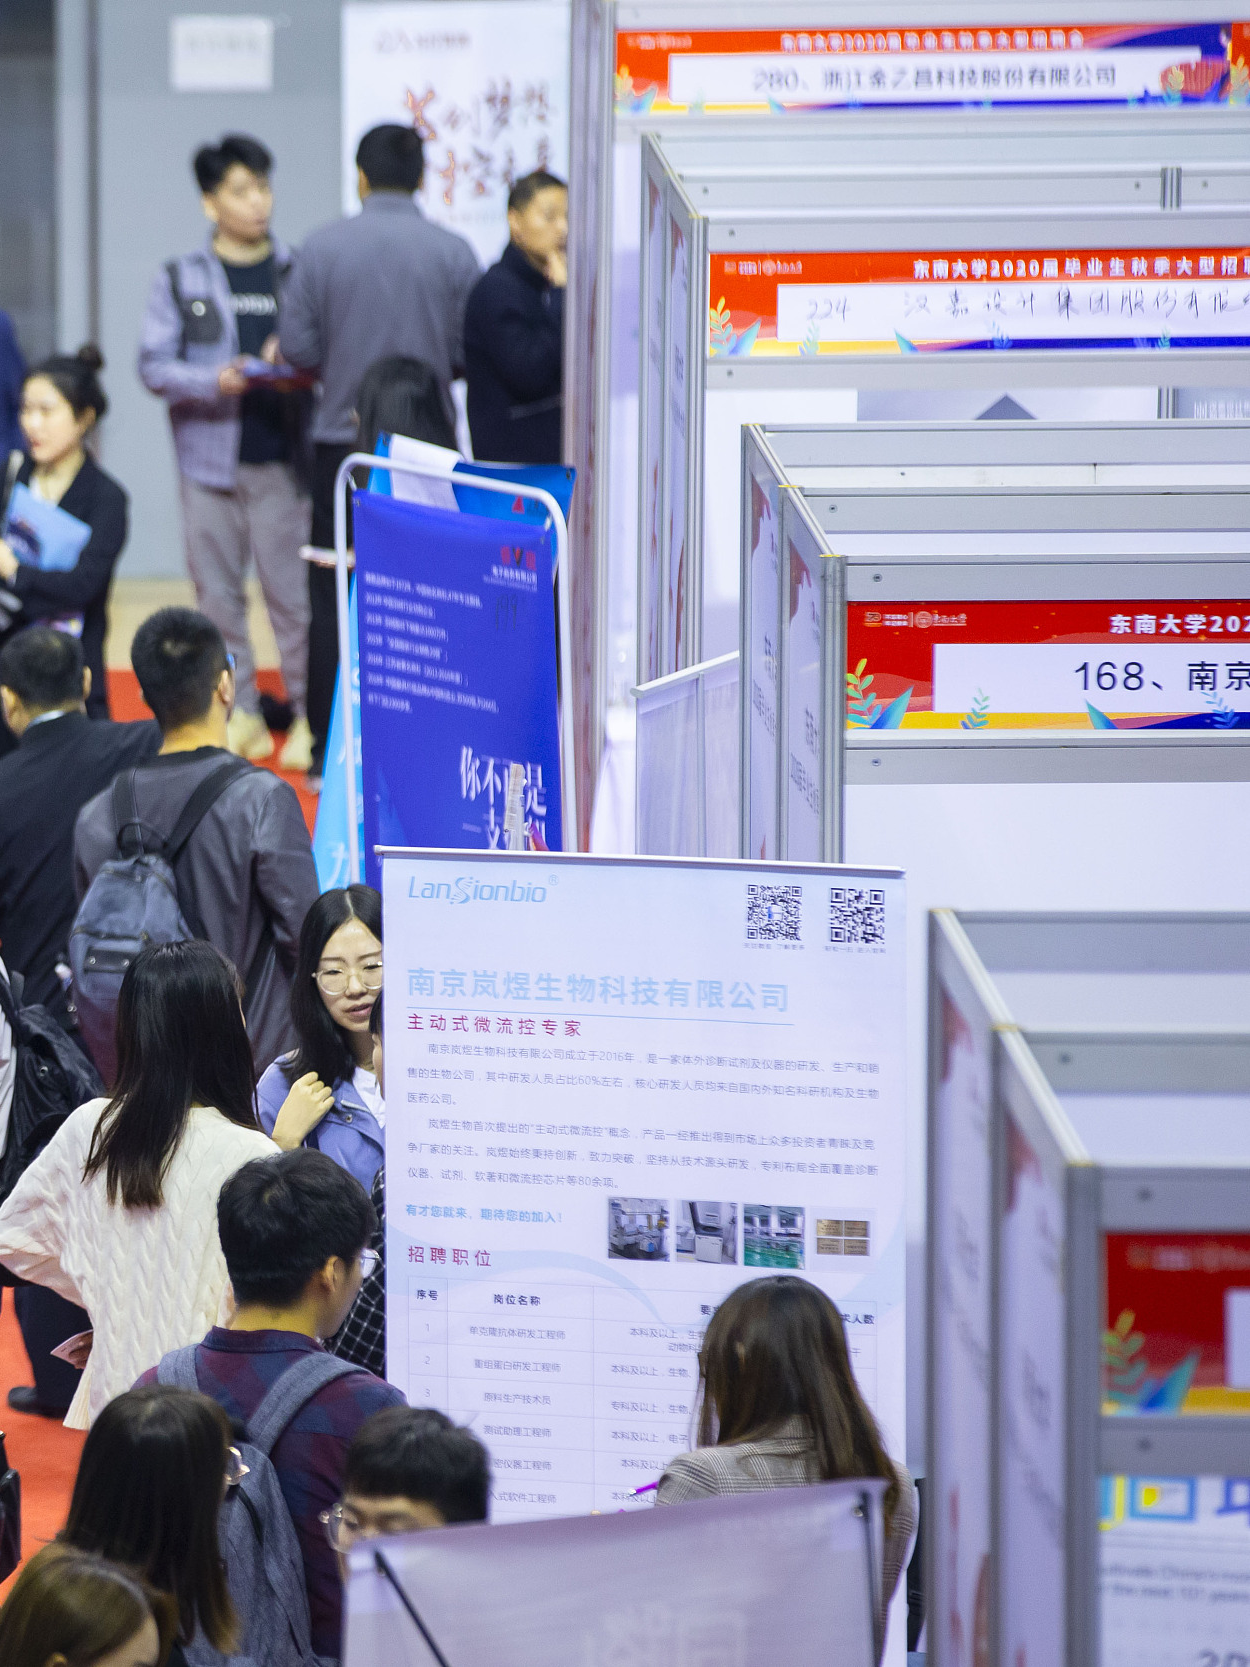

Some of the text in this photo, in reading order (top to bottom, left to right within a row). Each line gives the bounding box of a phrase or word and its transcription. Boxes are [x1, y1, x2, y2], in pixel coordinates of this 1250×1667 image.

[460, 745, 547, 816] 你不是
[407, 967, 789, 1013] 南京岚煜生物科技有限公司
[407, 1013, 582, 1036] 主动式微流控专家
[408, 1246, 492, 1267] 招聘职位
[416, 1289, 438, 1301] 序号
[493, 1293, 541, 1307] 岗位名称
[483, 1391, 552, 1405] 原料生产技术员
[483, 1425, 552, 1438] 测试助理工程师
[492, 1458, 552, 1471] 密仪器工程师
